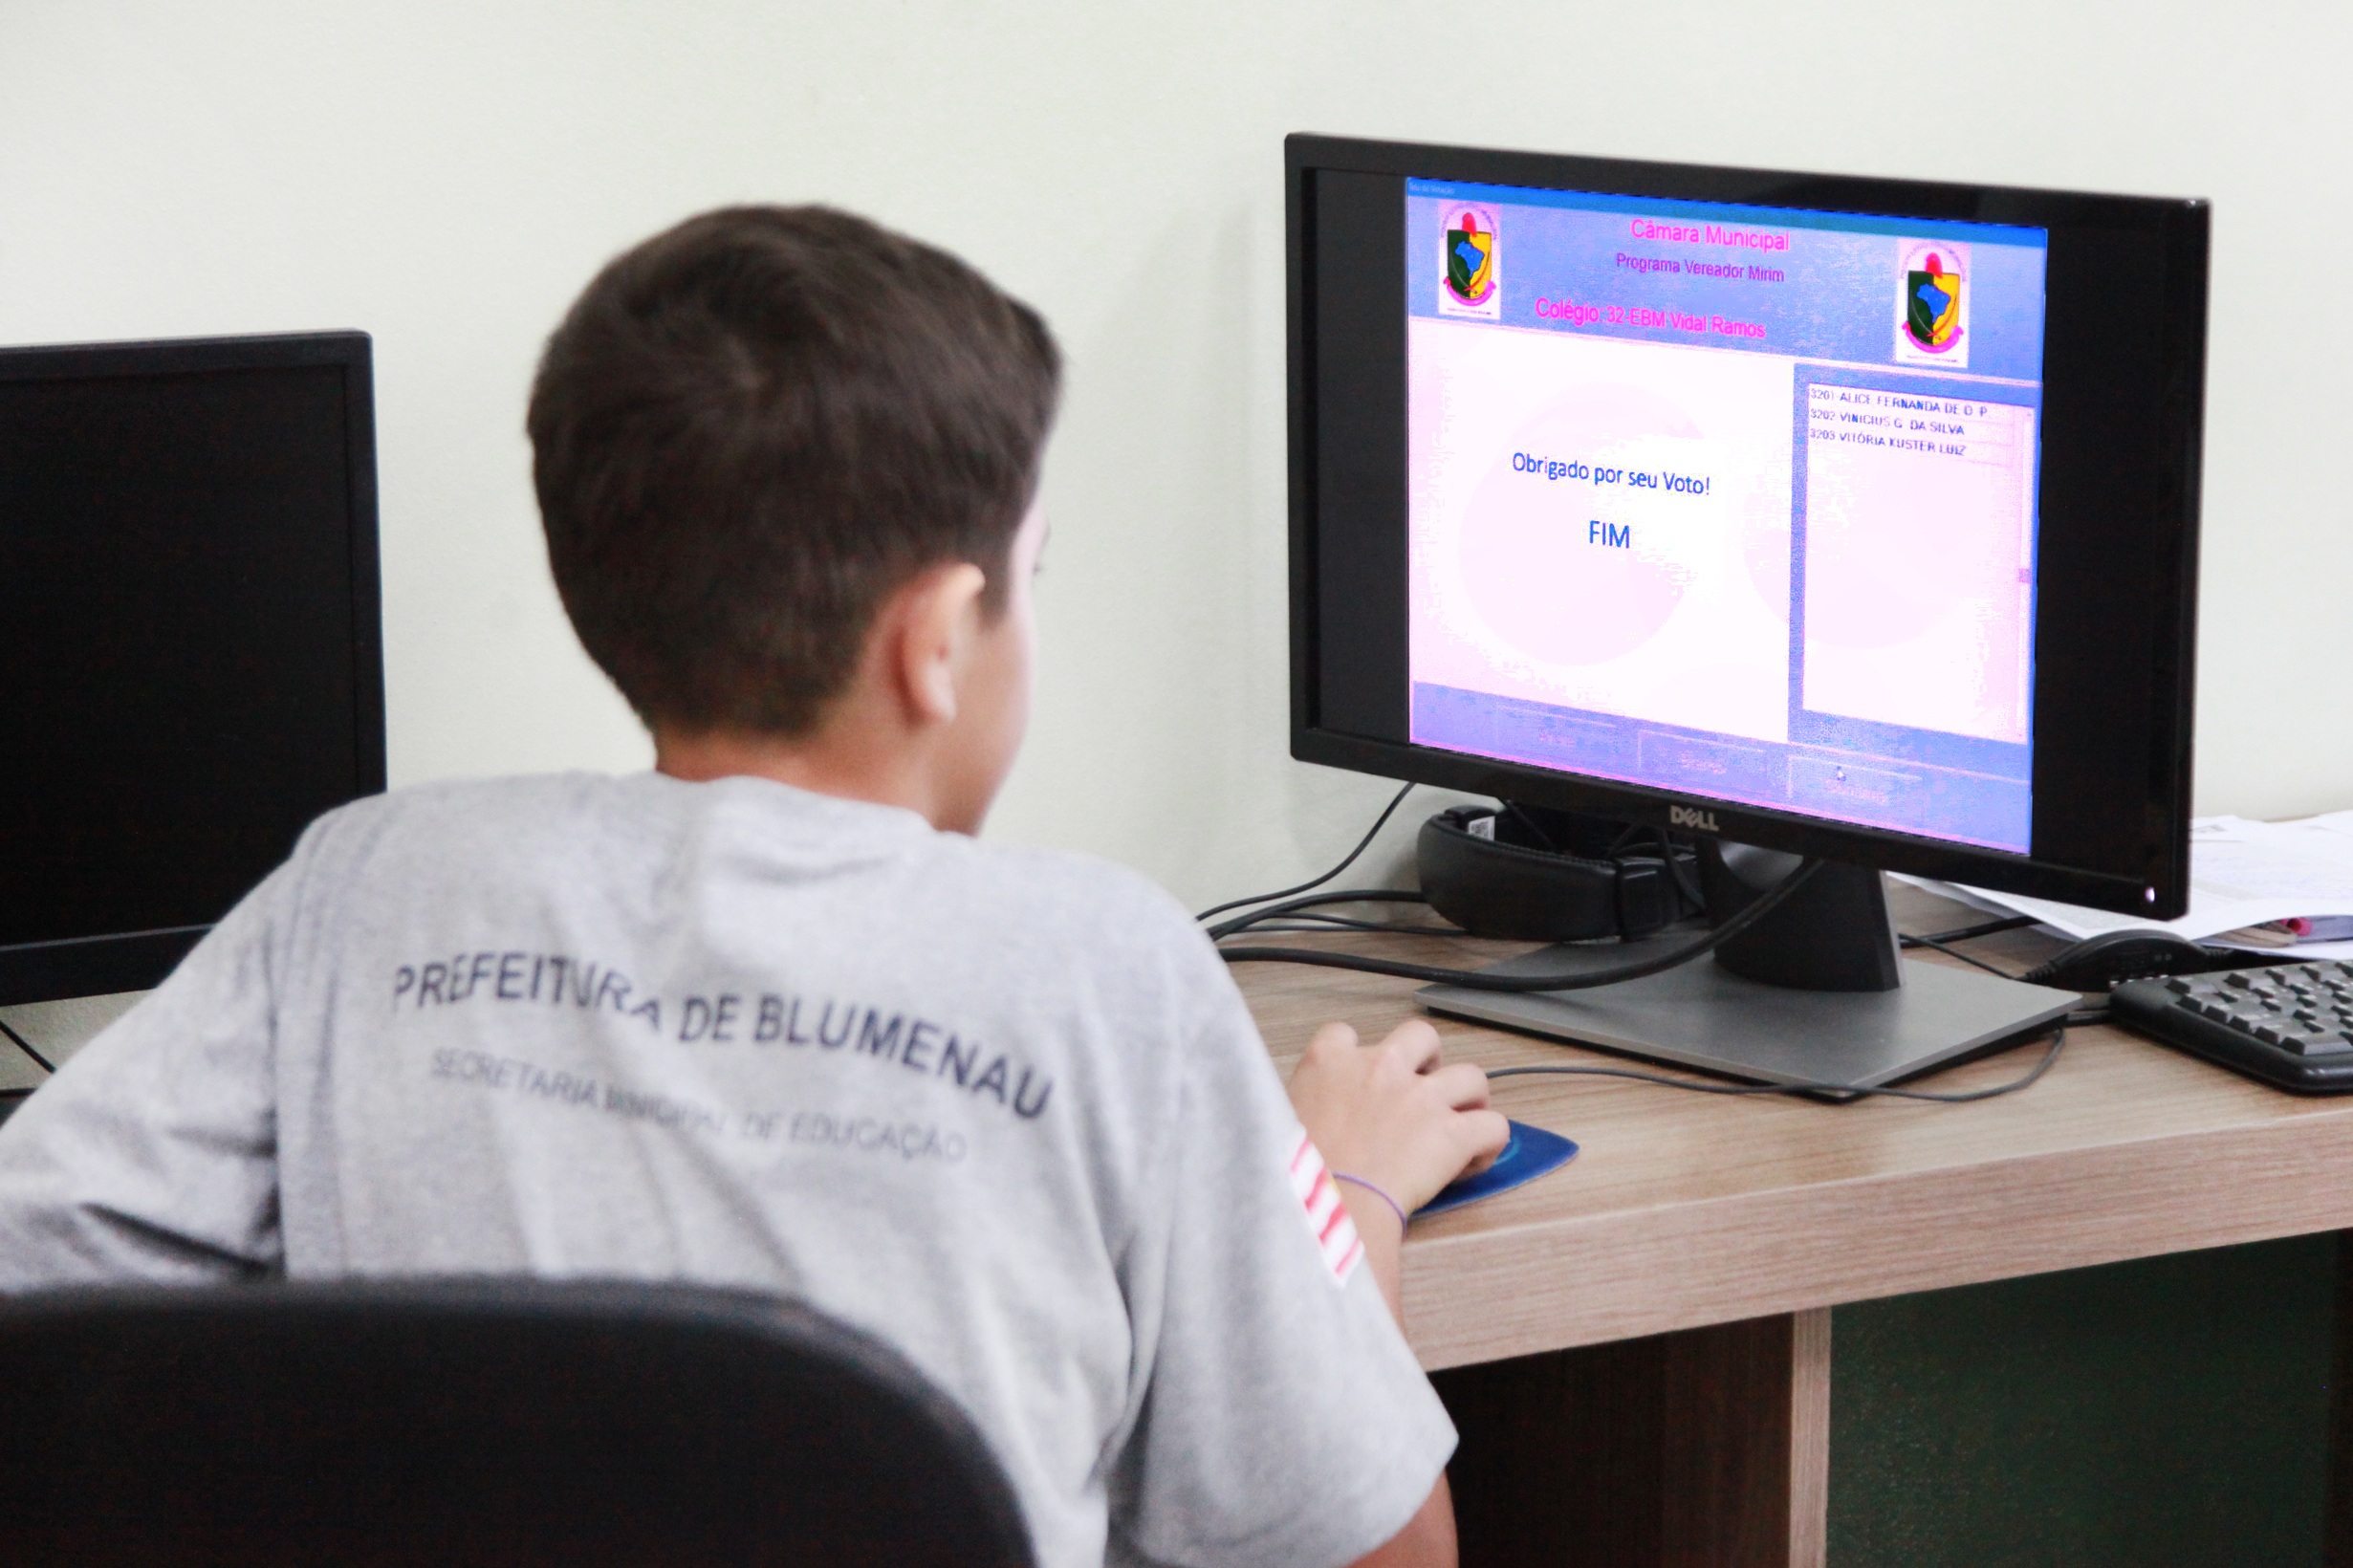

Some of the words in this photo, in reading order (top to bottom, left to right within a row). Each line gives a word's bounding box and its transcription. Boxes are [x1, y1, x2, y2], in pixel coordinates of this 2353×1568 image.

[1630, 218, 1700, 243] Câmara
[1705, 225, 1790, 253] Municipal
[1616, 252, 1681, 273] Programa
[1685, 259, 1744, 279] Vereador
[1748, 265, 1785, 283] Mirim
[1669, 312, 1708, 333] Vidal
[1710, 315, 1767, 339] Ramos
[1810, 388, 1834, 402] 3201
[1840, 392, 1870, 404] ALICE
[1877, 395, 1940, 413] FERNANDA
[1945, 403, 1960, 415] DE
[1909, 419, 1927, 431] DA
[1929, 421, 1965, 436] SILVA
[1939, 442, 1967, 456] LUIZ
[1513, 452, 1589, 481] Obrigado
[1594, 467, 1623, 486] por
[1628, 470, 1658, 490] seu
[1663, 471, 1710, 496] Voto!
[1589, 519, 1630, 549] FIM
[1669, 804, 1720, 833] DELL
[393, 950, 662, 1033] PREFEITURA
[680, 993, 741, 1044] DE
[753, 992, 1053, 1120] BLUMENAU
